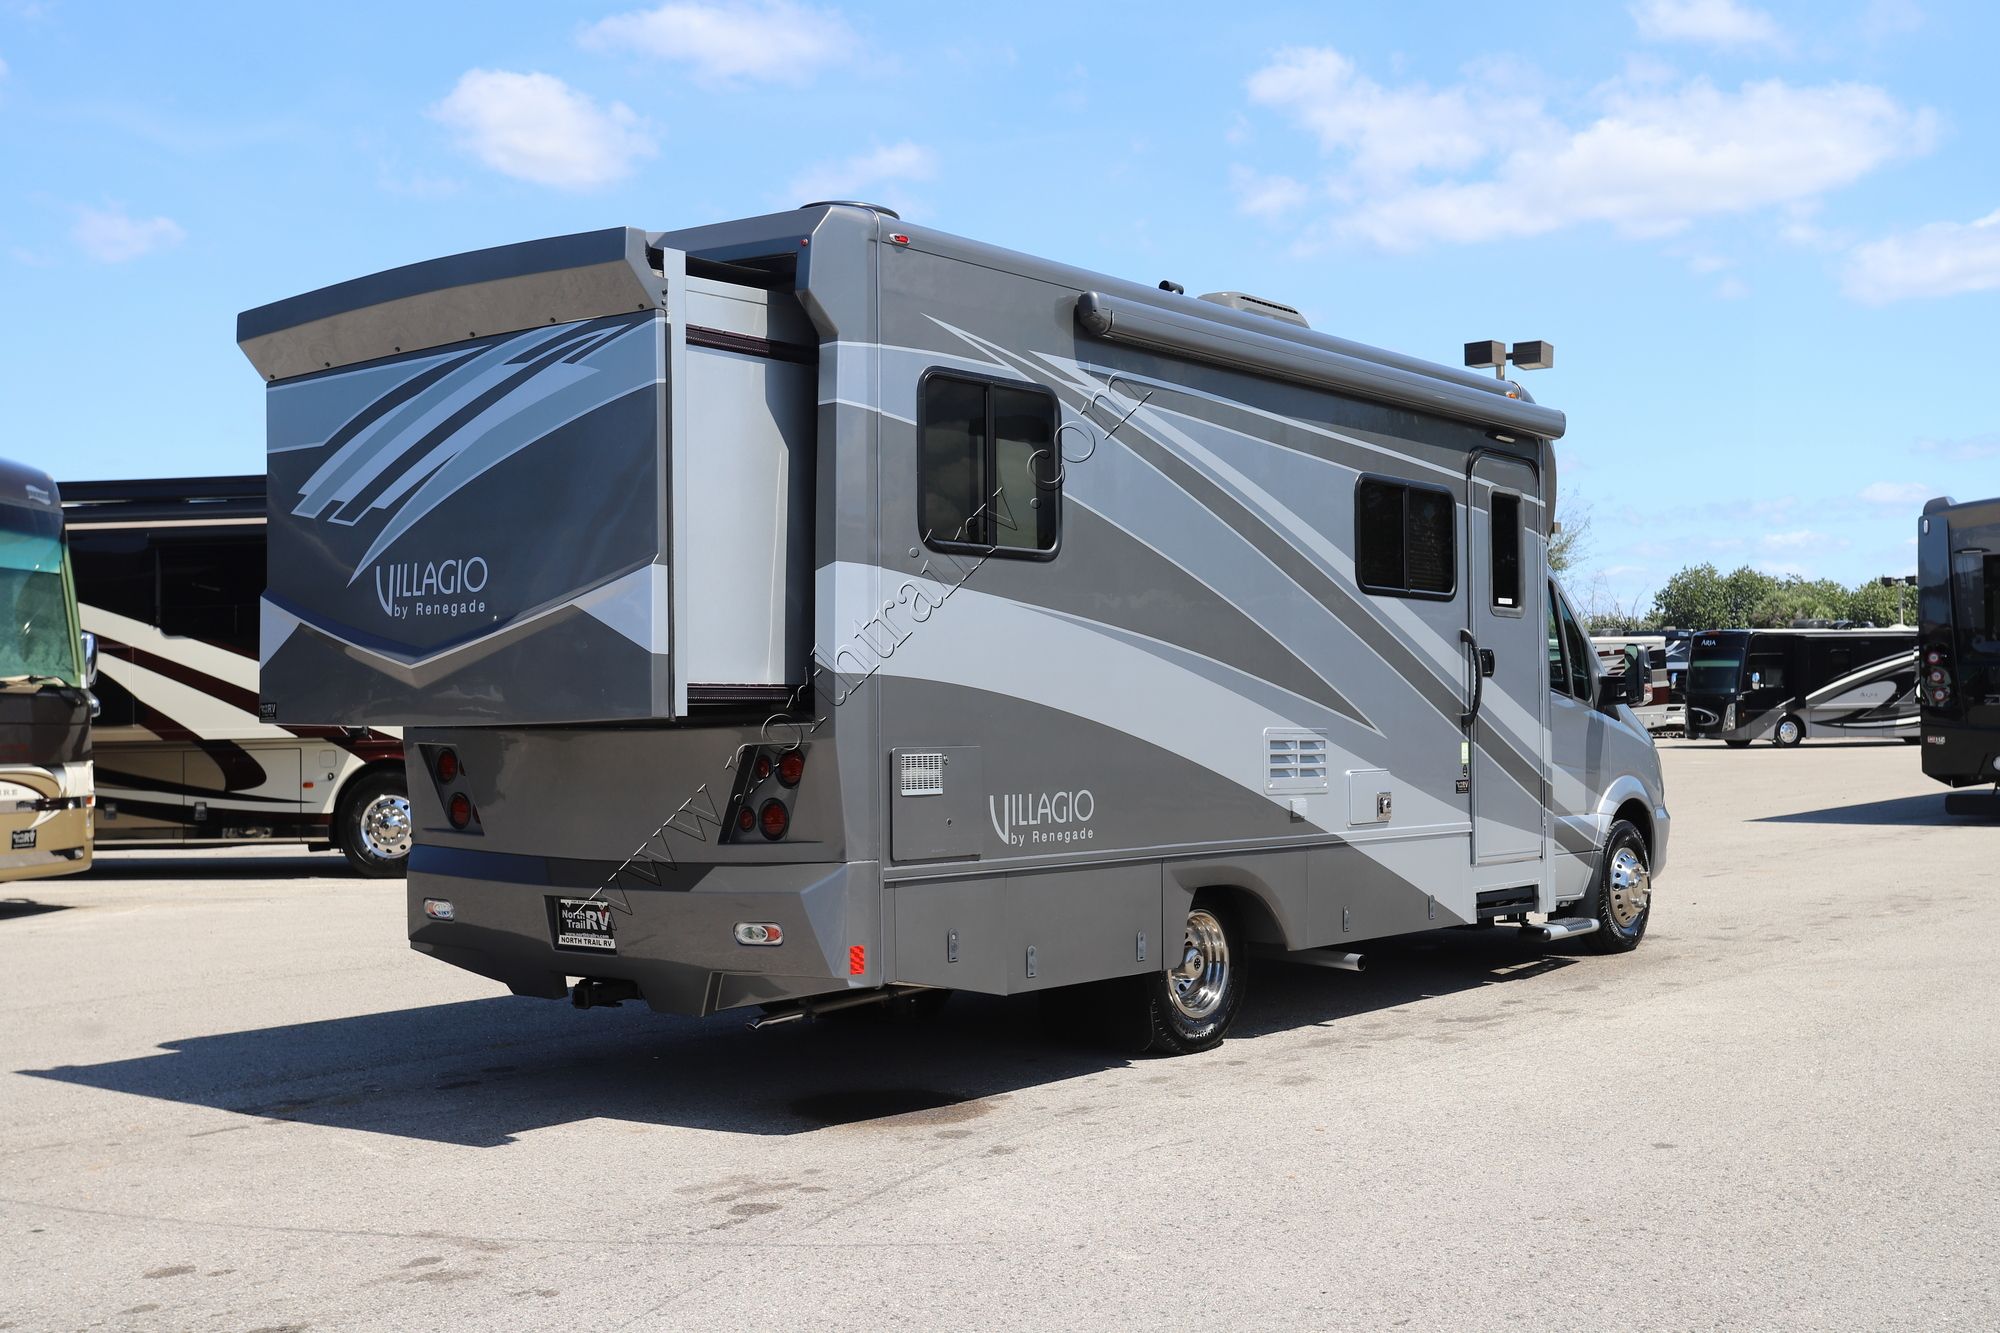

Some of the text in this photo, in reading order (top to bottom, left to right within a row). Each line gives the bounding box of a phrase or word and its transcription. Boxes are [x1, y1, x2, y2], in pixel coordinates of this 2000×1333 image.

[376, 556, 488, 617] VILLAGIO
[394, 600, 485, 619] by Renegade
[989, 789, 1094, 844] VILLAGIO
[1011, 827, 1093, 847] by Renegade
[561, 910, 610, 931] North RV
[566, 919, 586, 929] Trail
[561, 936, 583, 944] NORTH
[584, 938, 602, 946] TRAIL
